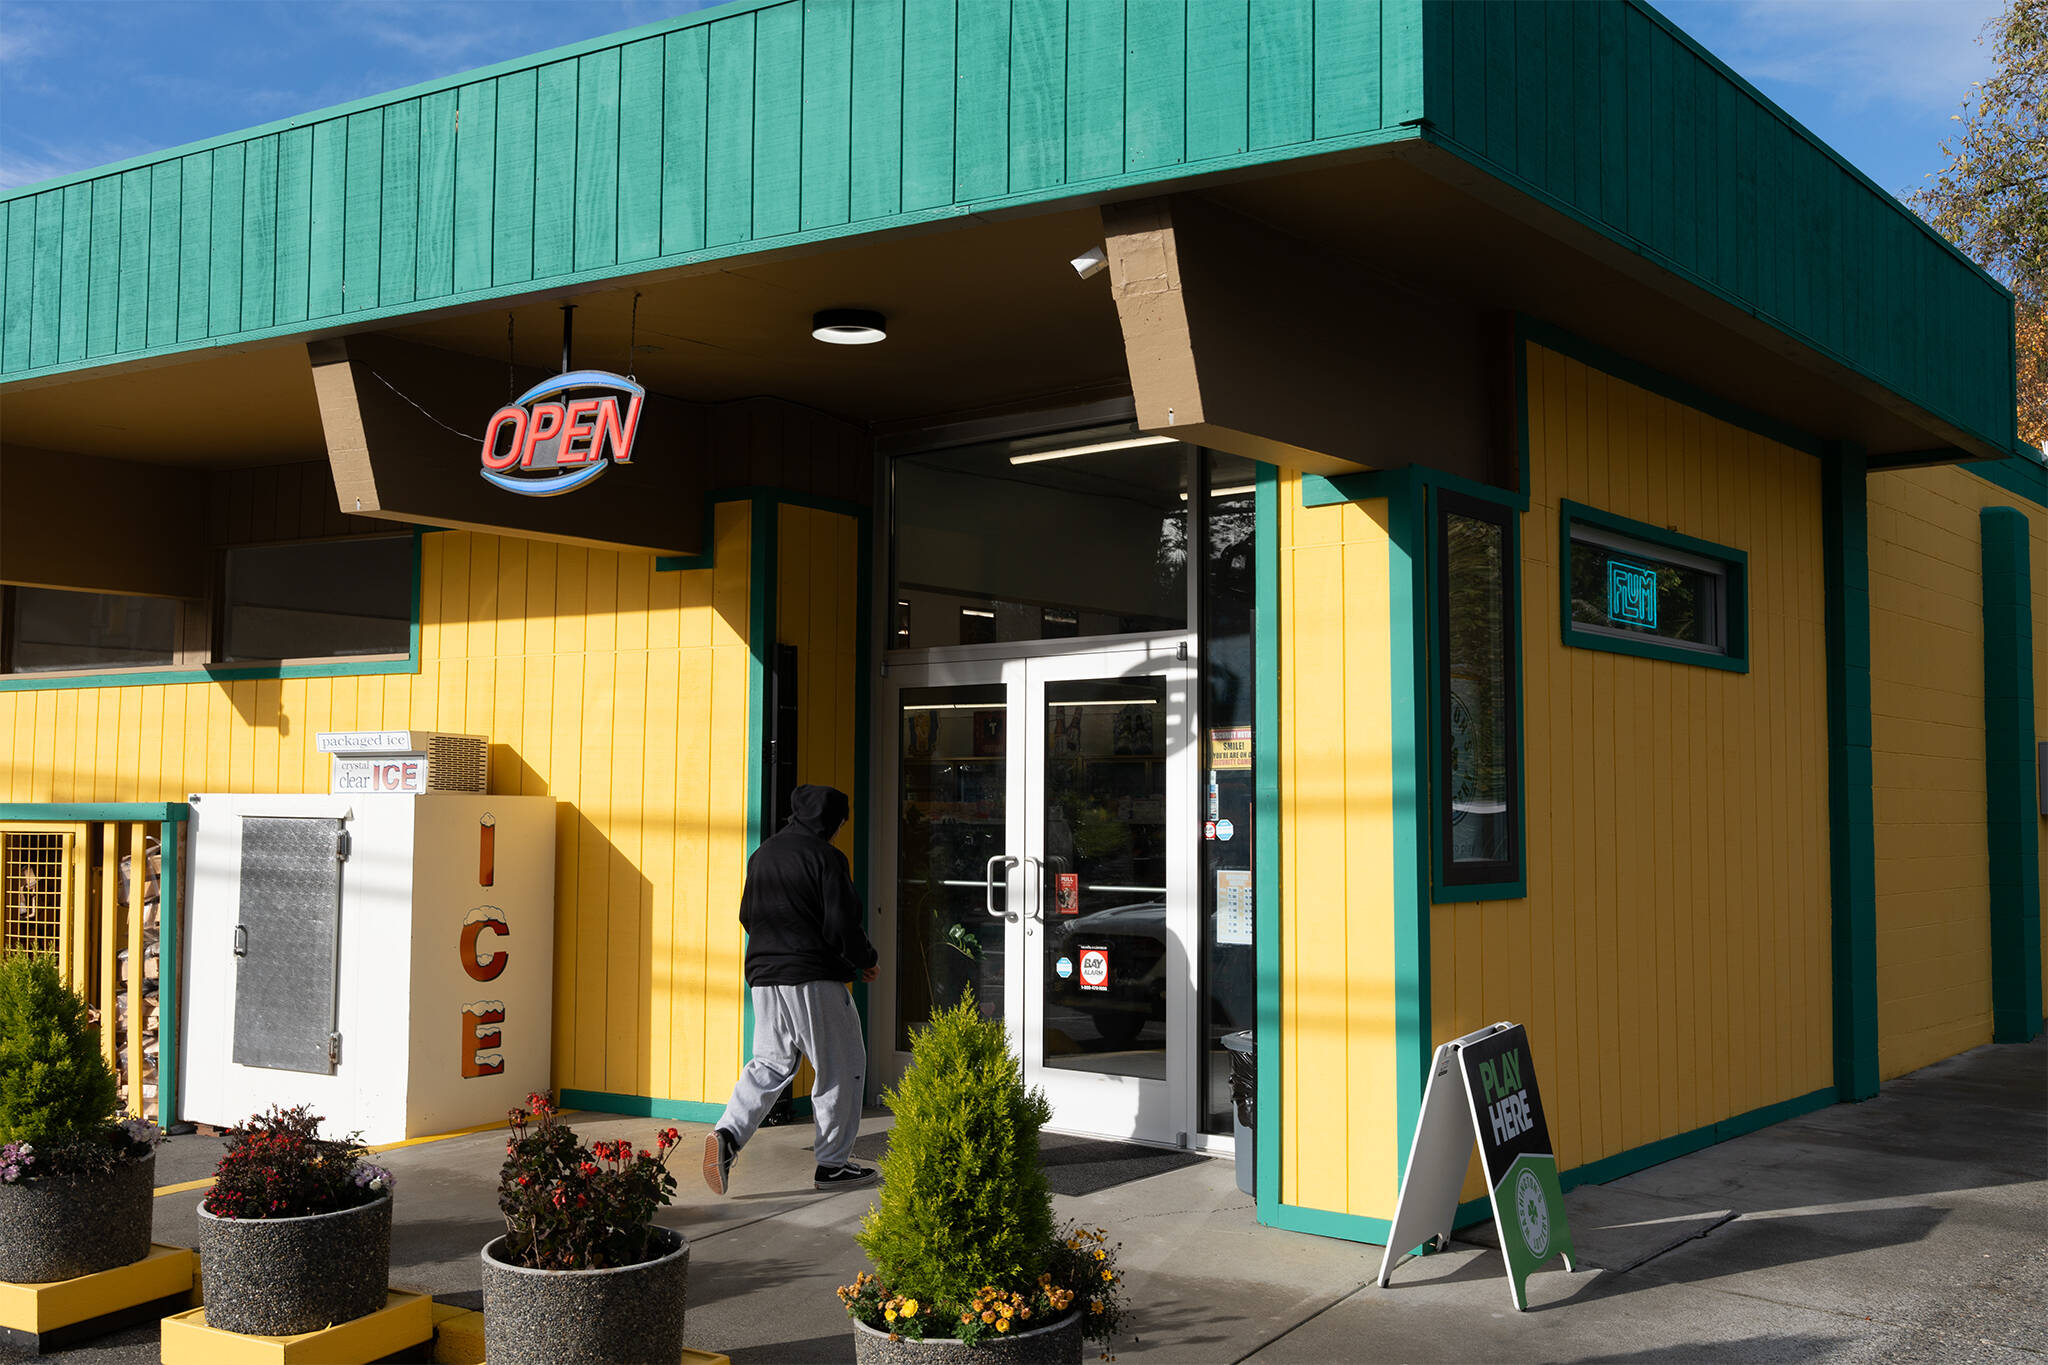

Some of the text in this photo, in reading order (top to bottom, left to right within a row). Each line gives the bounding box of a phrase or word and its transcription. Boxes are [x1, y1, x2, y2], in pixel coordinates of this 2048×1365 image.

[481, 395, 643, 470] OPEN
[1612, 569, 1654, 622] FLUM
[322, 734, 406, 749] packaged ice
[1223, 741, 1245, 750] SMILE!
[339, 772, 370, 788] clear
[341, 760, 417, 790] crystal ICE
[460, 812, 510, 1079] ICE
[1084, 958, 1104, 969] BAY
[1479, 1047, 1523, 1105] PLAY
[1488, 1089, 1534, 1147] HERE
